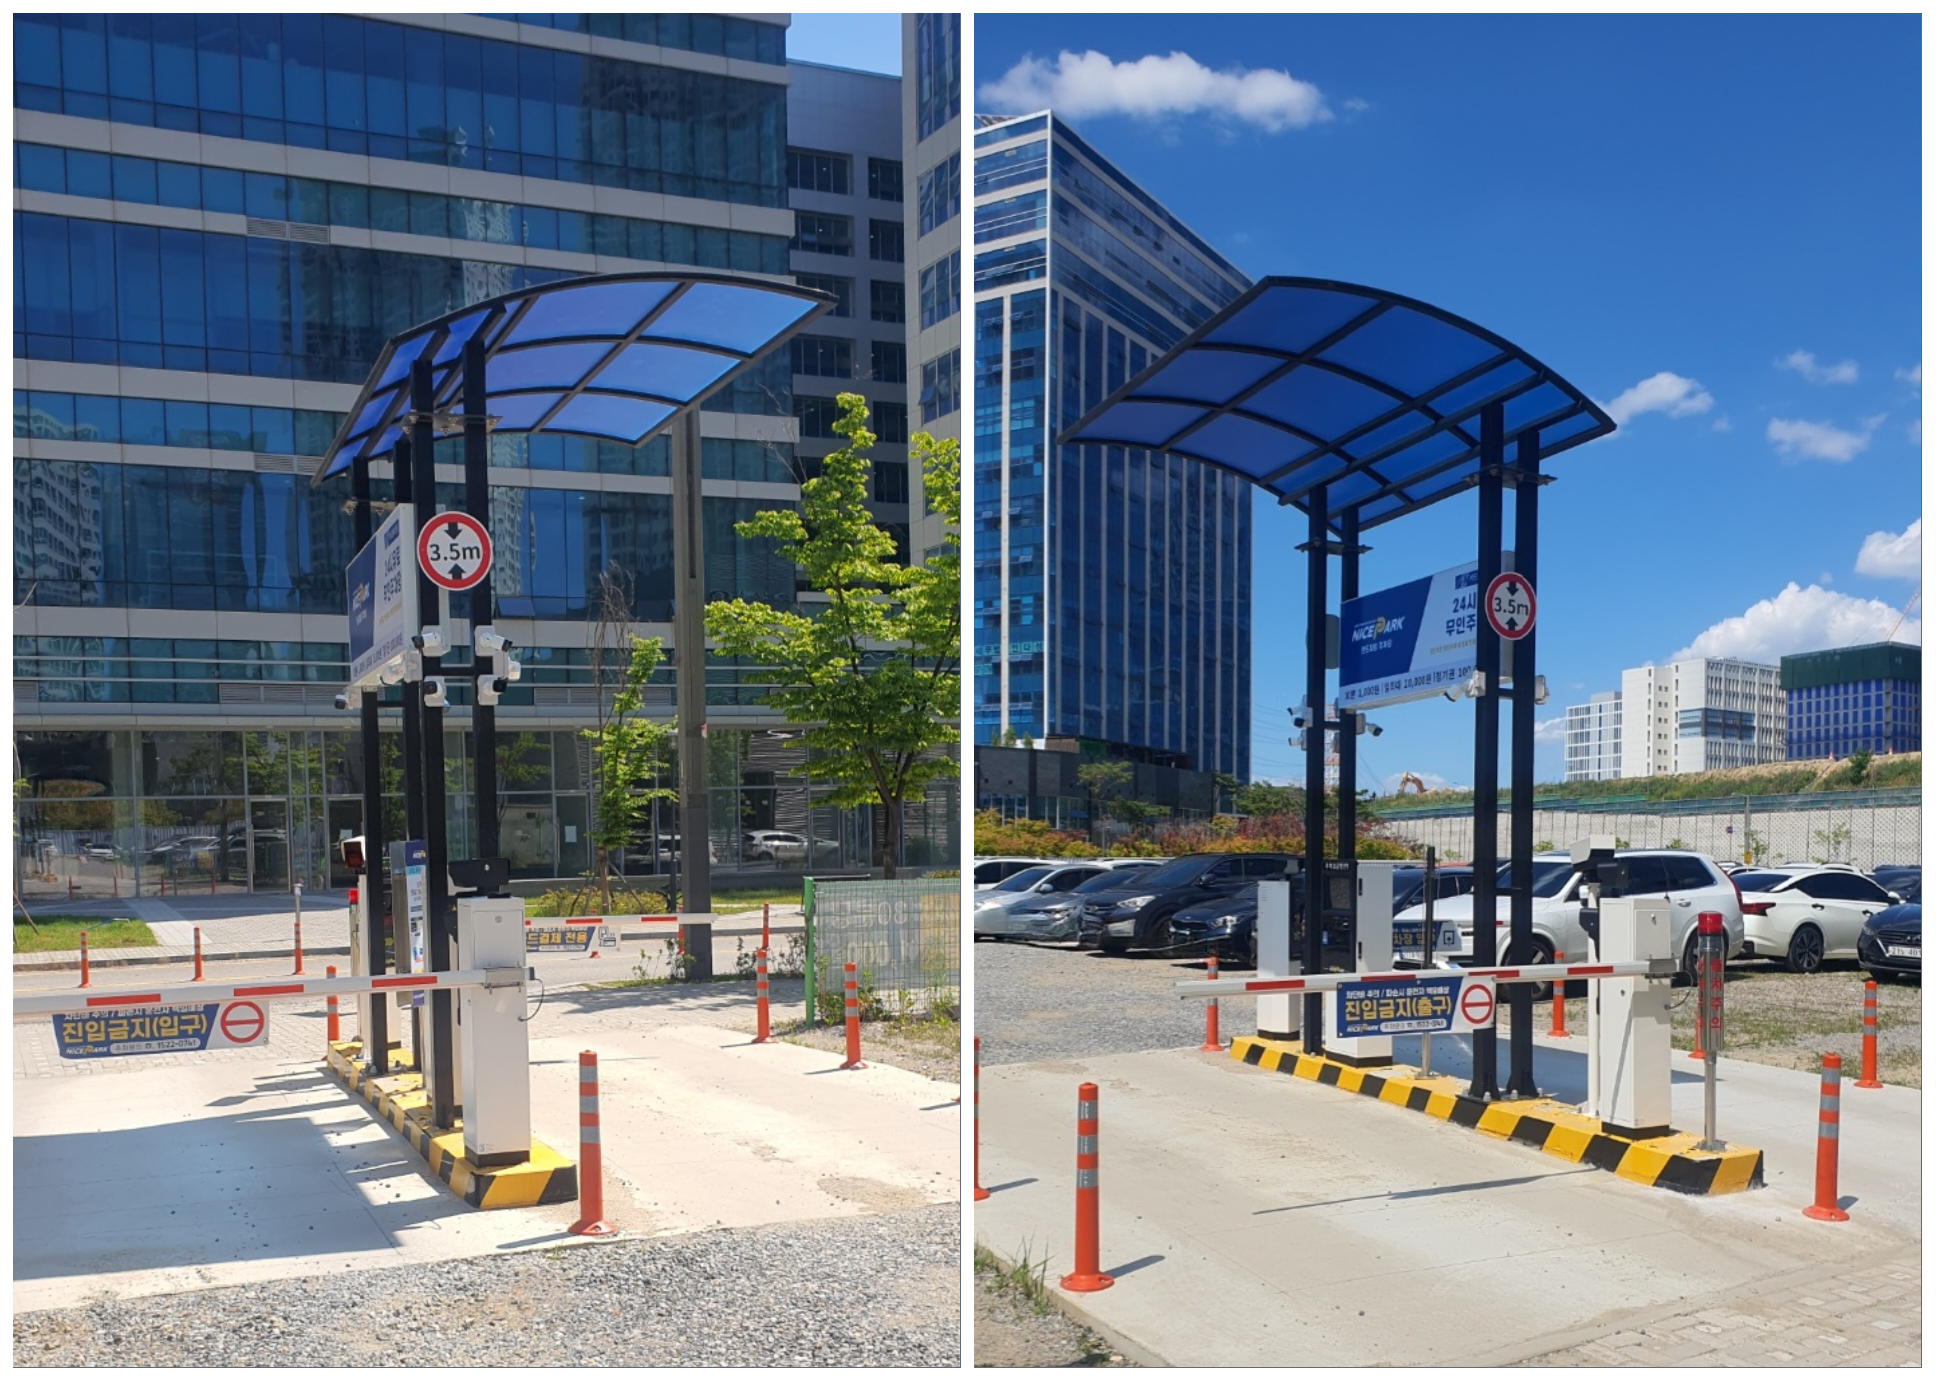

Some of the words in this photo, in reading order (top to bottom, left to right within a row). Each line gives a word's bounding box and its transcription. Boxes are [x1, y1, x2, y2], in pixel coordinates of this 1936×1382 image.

[429, 542, 480, 562] 3.5m
[1452, 591, 1476, 613] 24시
[1493, 596, 1529, 616] 3.5m
[1351, 615, 1405, 643] NICEPARK
[1446, 613, 1476, 636] 무인주
[565, 931, 588, 944] 전용
[1366, 989, 1380, 998] 주의
[1345, 996, 1452, 1022] 진입금지(출구)
[61, 1013, 207, 1043] 진입금지(입구)
[66, 1045, 109, 1055] NICEPARK
